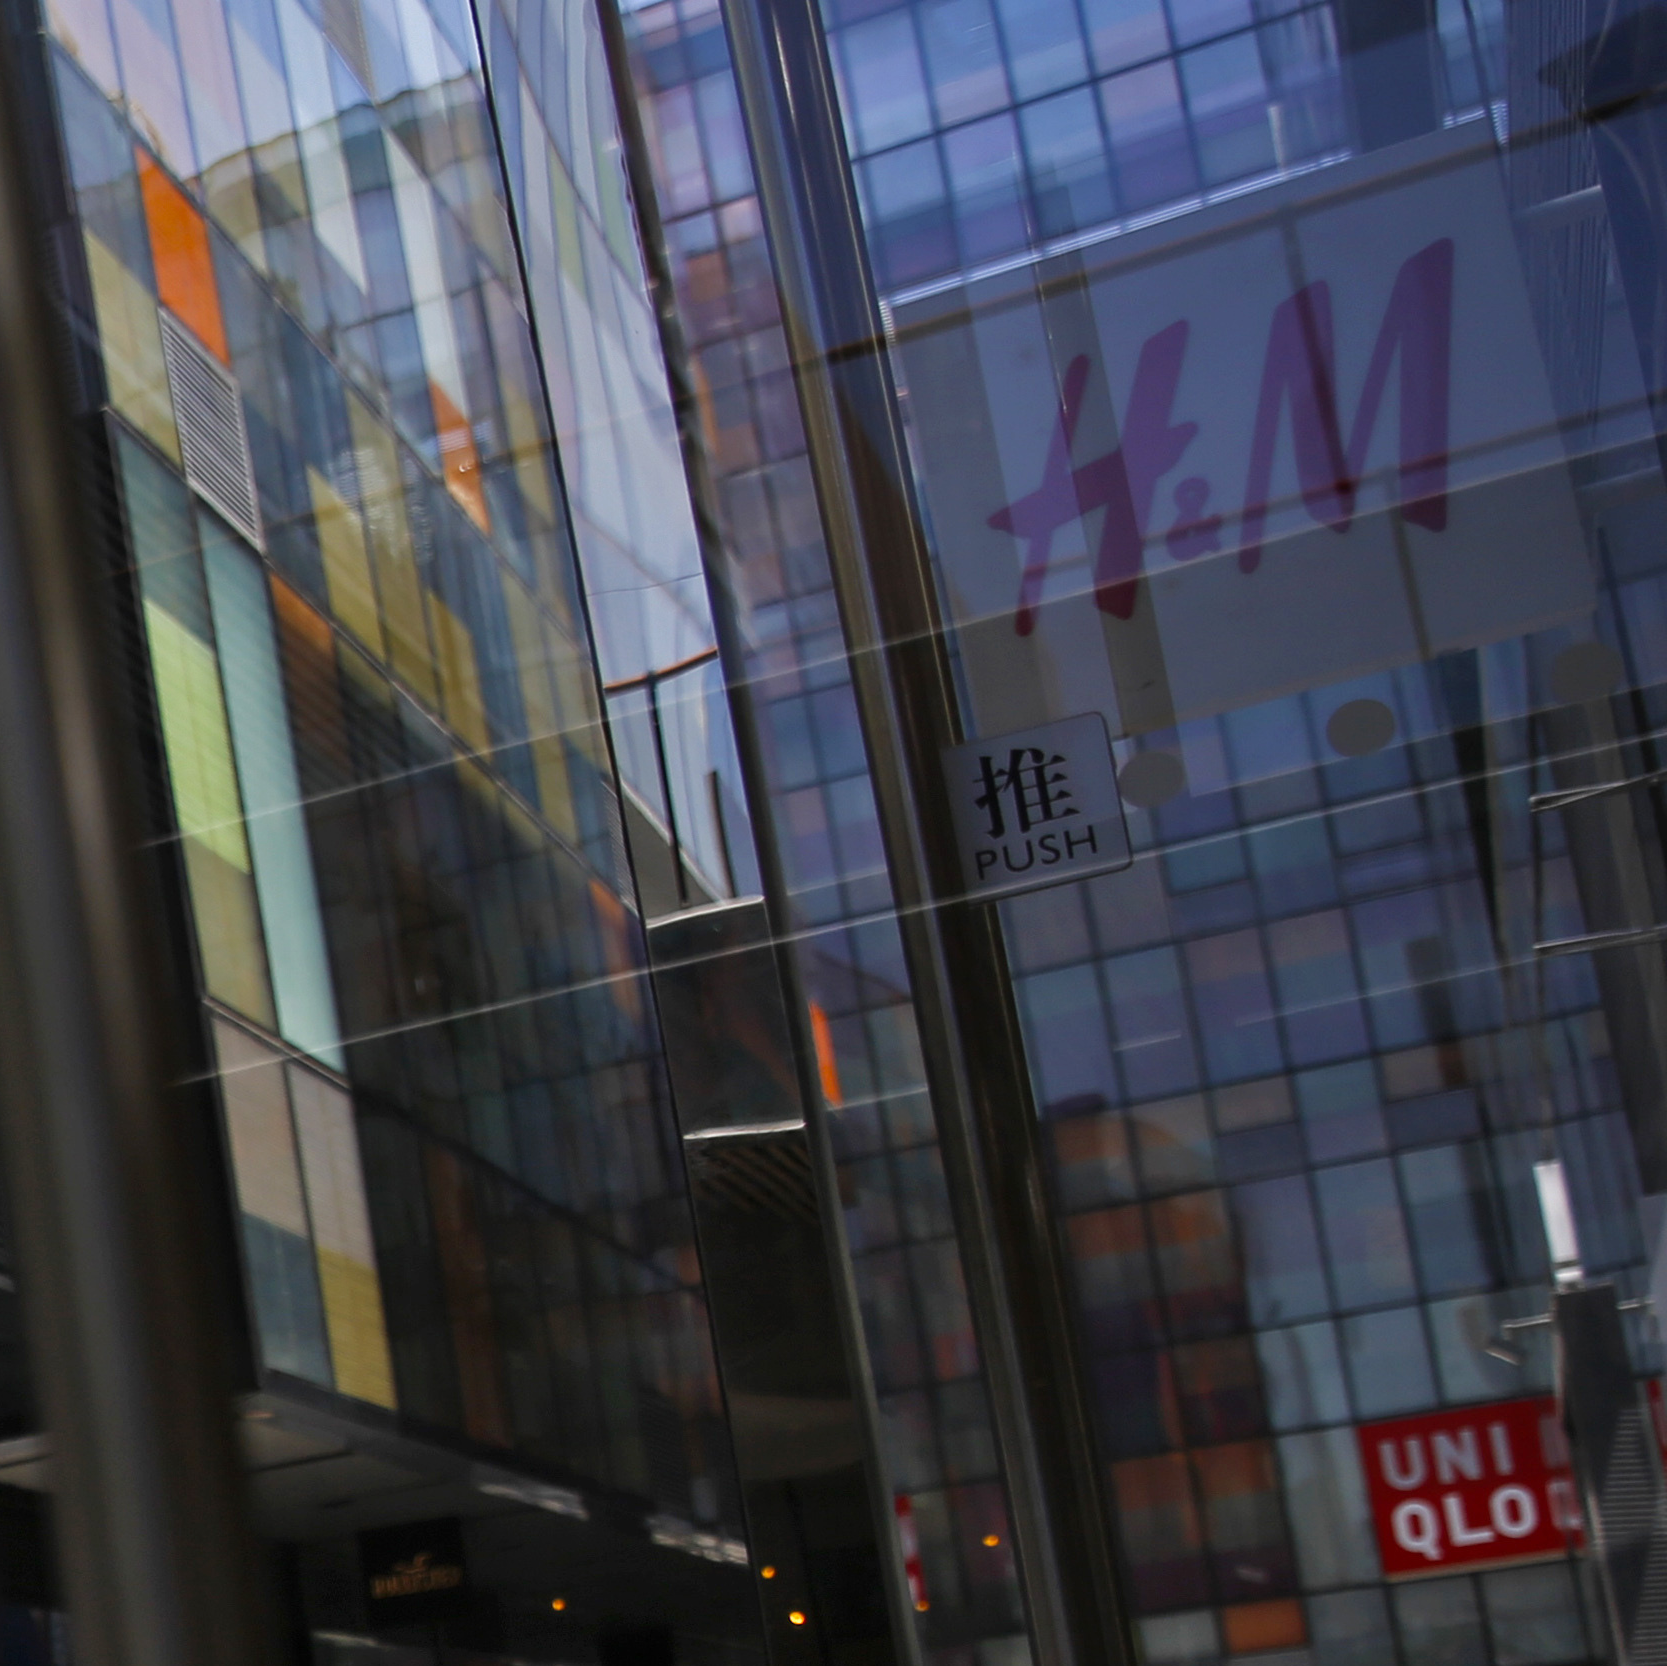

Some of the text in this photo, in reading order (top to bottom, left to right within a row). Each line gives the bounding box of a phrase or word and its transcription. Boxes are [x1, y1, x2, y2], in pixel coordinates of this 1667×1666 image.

[986, 237, 1455, 637] H&M
[972, 748, 1081, 839] 推
[975, 825, 1098, 880] PUSH
[1377, 1420, 1516, 1492] UNI
[1389, 1483, 1540, 1561] QLO
